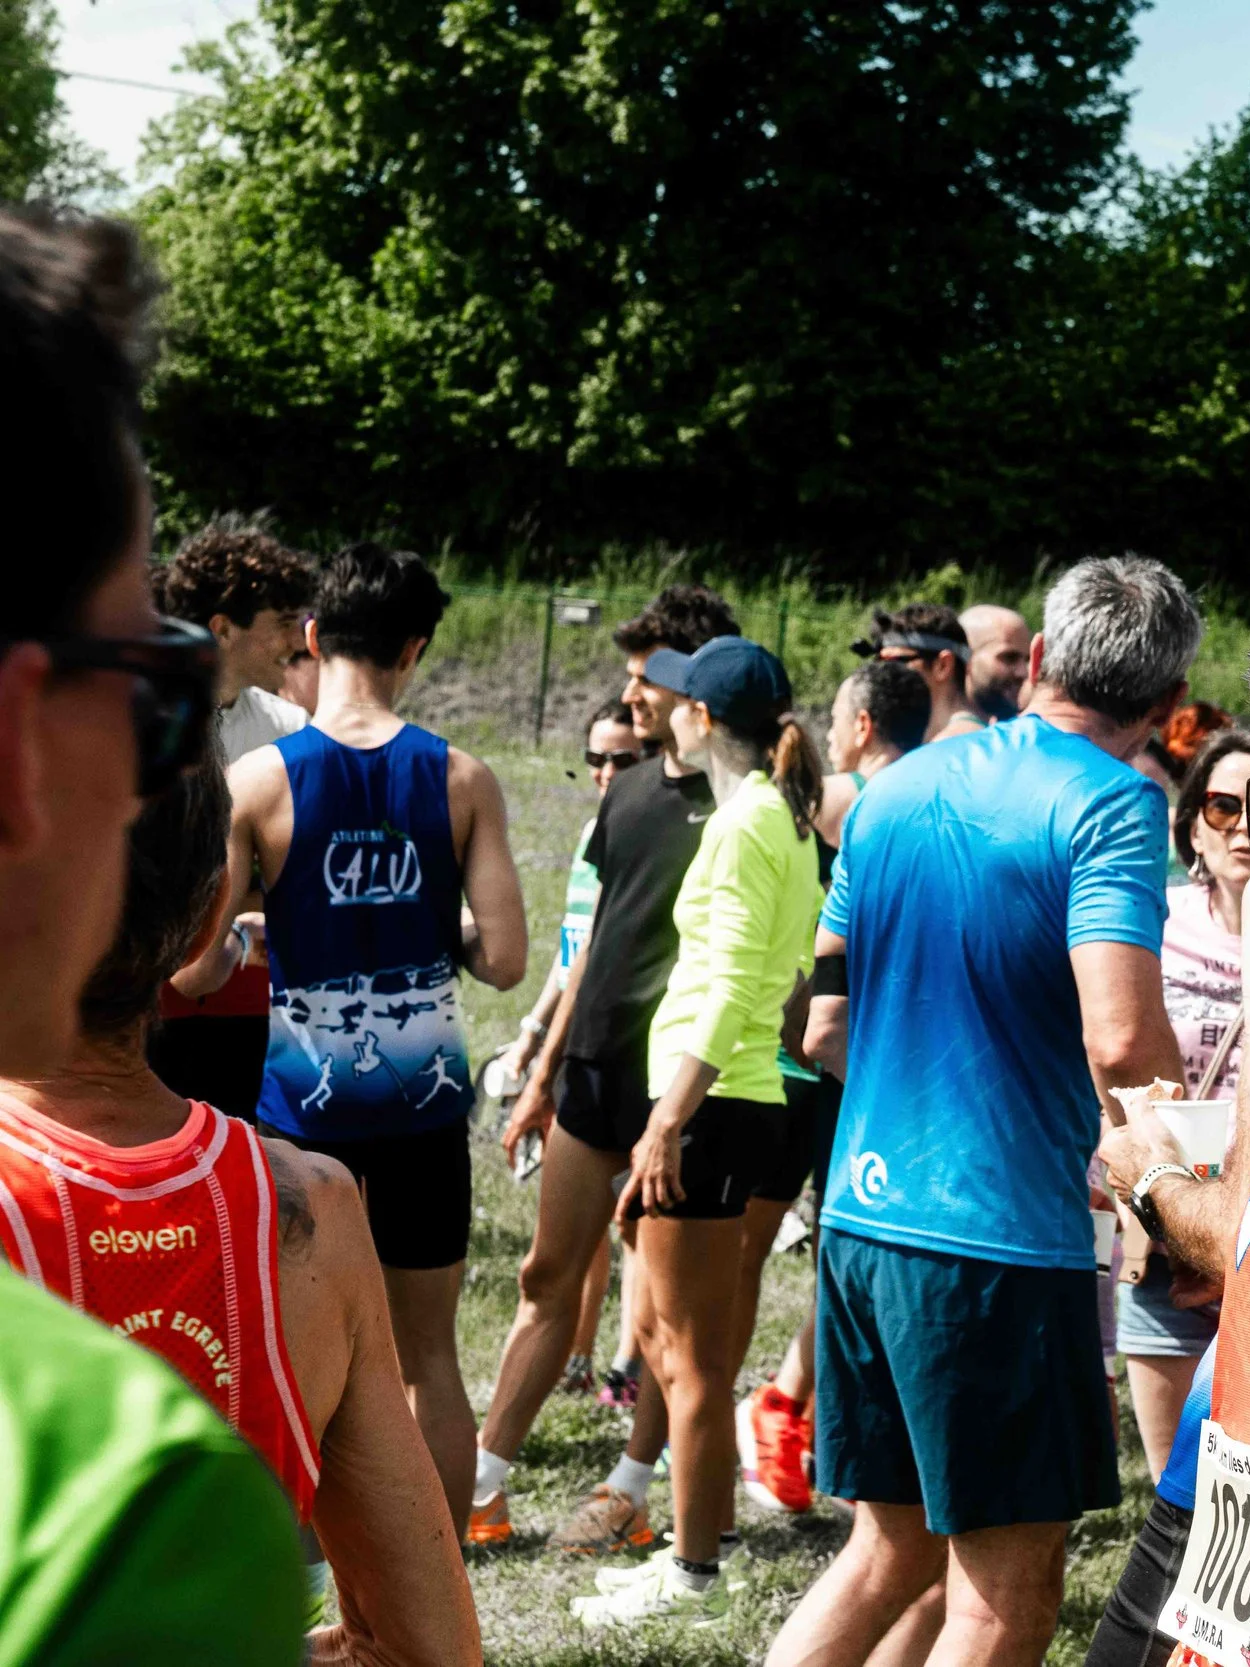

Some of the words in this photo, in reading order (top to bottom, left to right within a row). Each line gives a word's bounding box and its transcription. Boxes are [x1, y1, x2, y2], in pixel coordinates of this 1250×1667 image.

[89, 1225, 197, 1254] eleven
[112, 1308, 164, 1339] AINT
[1193, 1616, 1224, 1650] U.M.R.A
